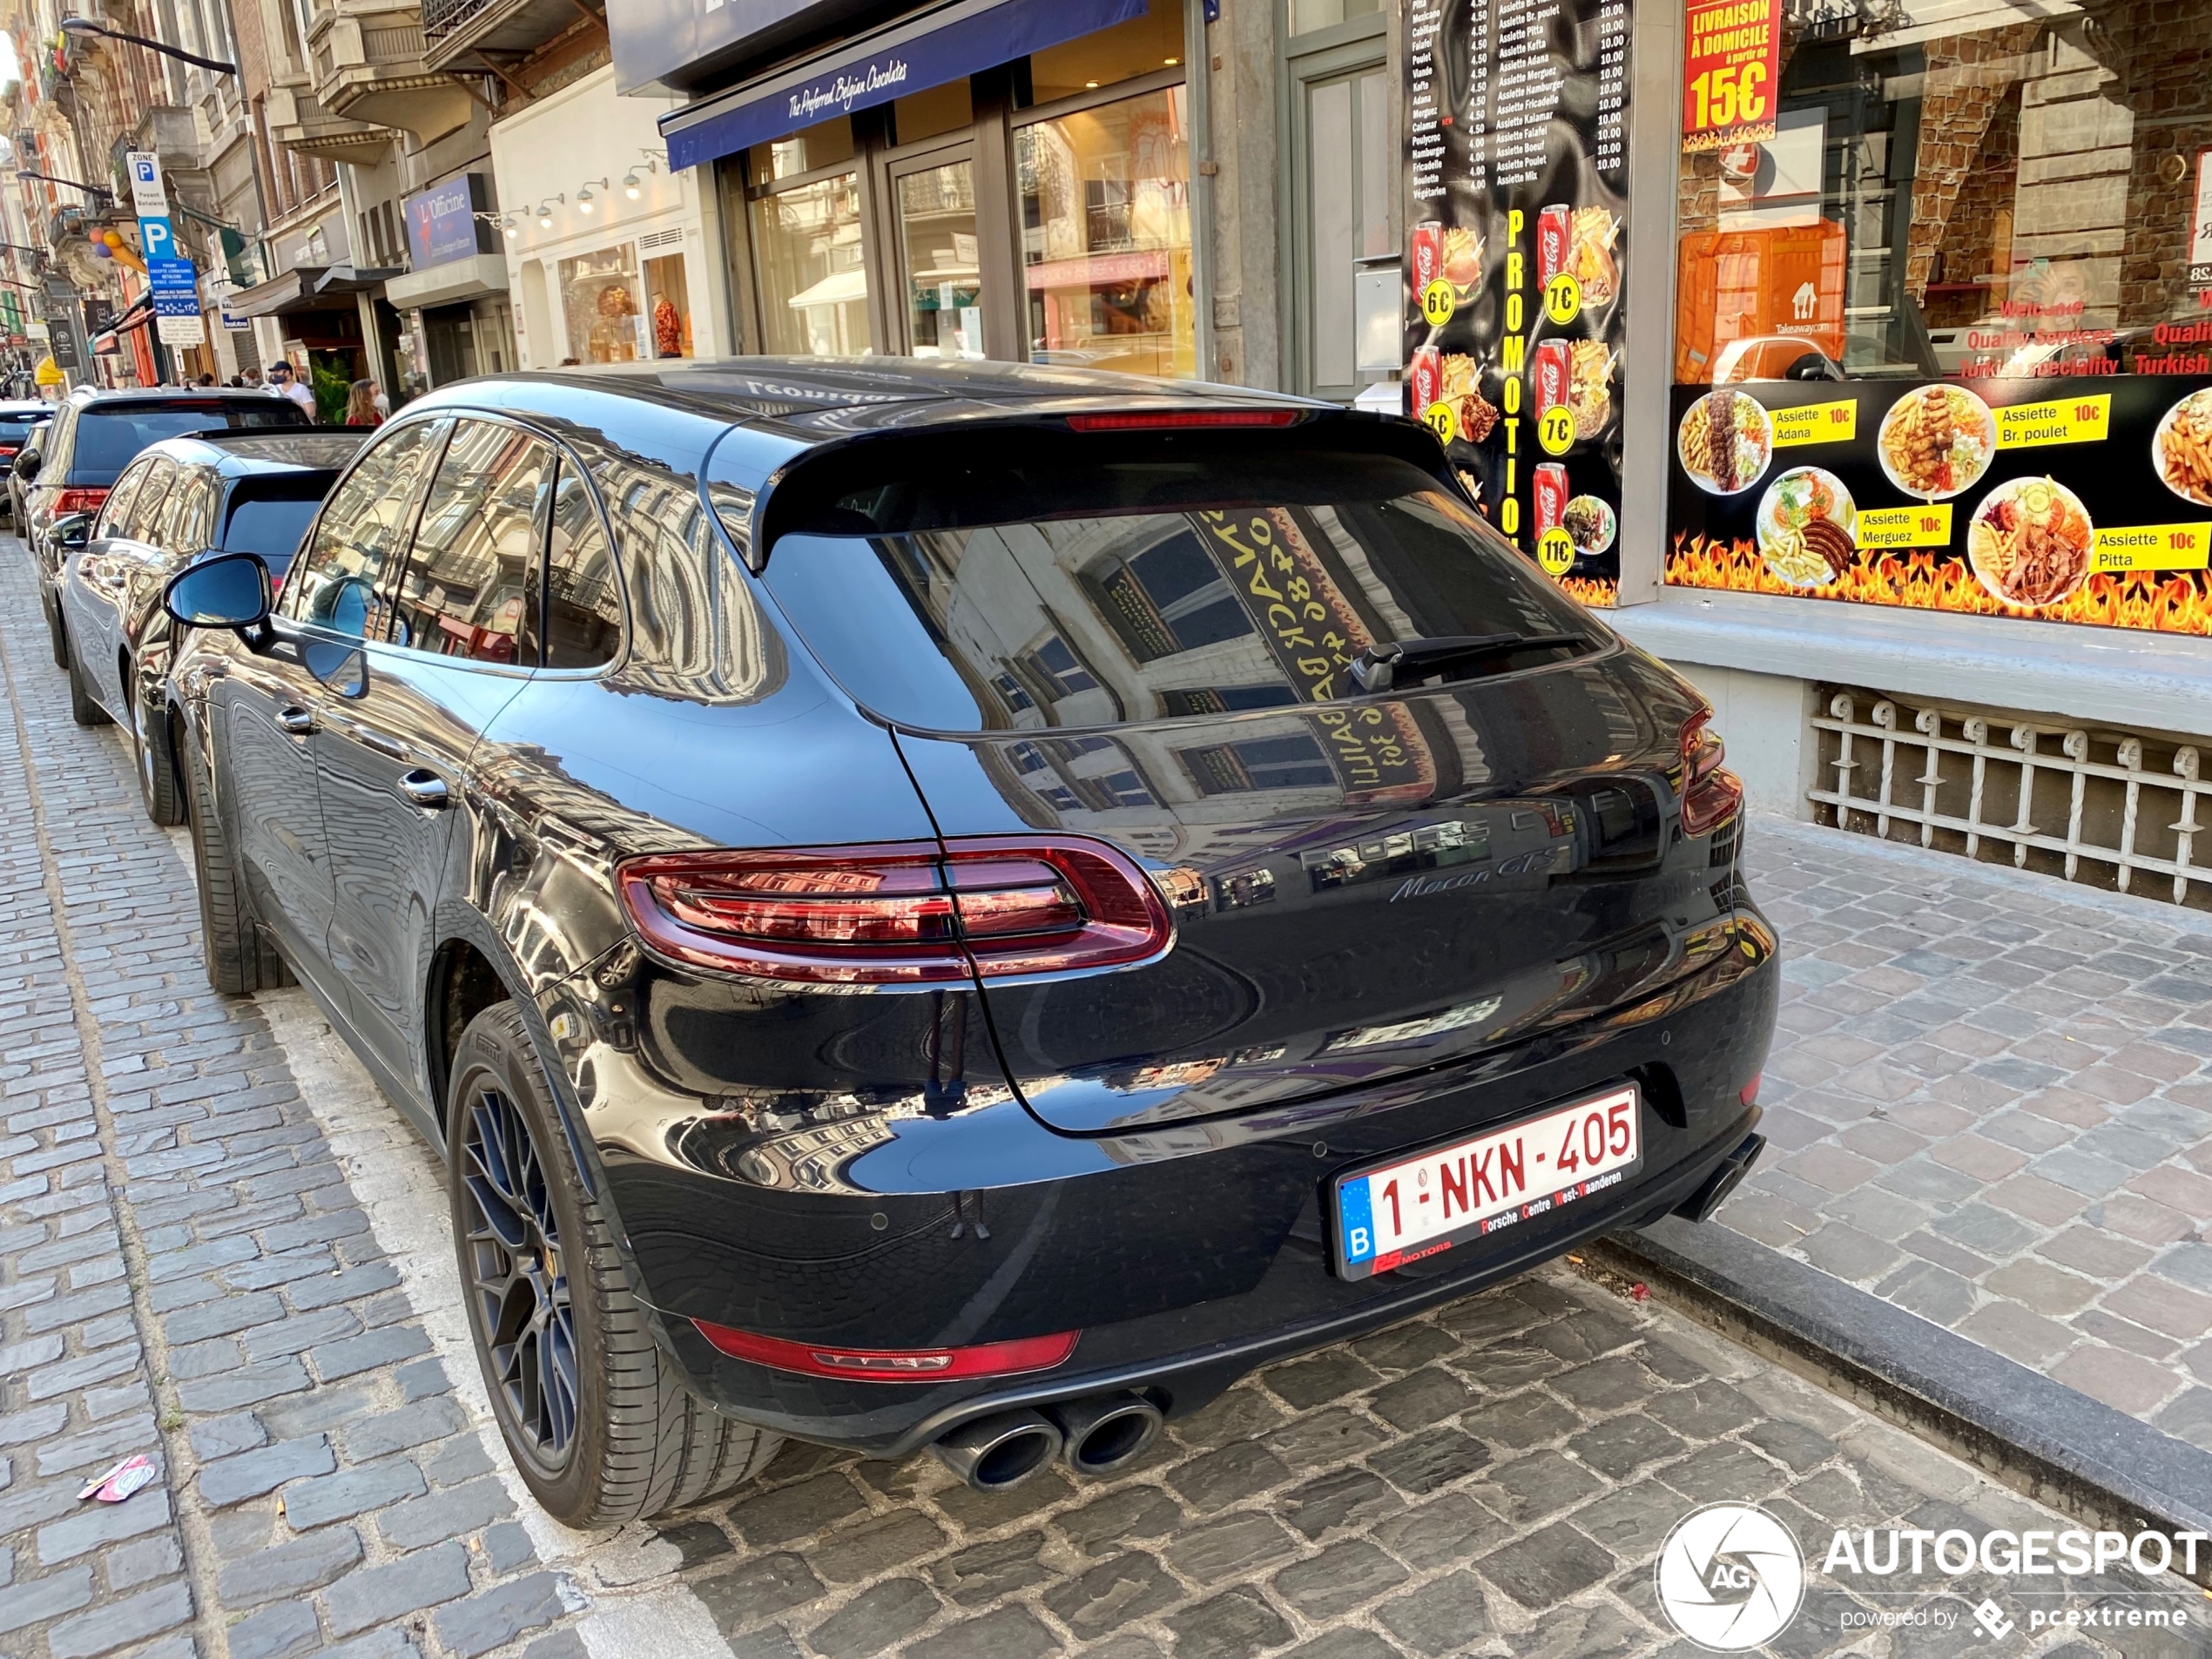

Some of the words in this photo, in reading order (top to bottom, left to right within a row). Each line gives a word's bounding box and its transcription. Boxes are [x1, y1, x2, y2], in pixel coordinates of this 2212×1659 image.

[1413, 10, 1440, 24] Mexicano
[1499, 0, 1525, 15] Assiette
[1499, 16, 1525, 29] Assiette
[1527, 11, 1536, 22] Br.
[1538, 4, 1560, 21] poulet
[1692, 0, 1770, 35] LIVRAISON
[1413, 22, 1440, 37] Cabillaud
[1471, 10, 1487, 23] 4.50
[1499, 30, 1526, 44] Assiette
[1527, 25, 1543, 37] Pitta
[1601, 3, 1623, 18] 10.00
[1413, 37, 1433, 52] Falafel
[1471, 24, 1487, 37] 4.50
[1500, 44, 1526, 58] Assiette
[1527, 39, 1546, 51] Kefta
[1601, 19, 1623, 34] 10.00
[1691, 33, 1701, 58] À
[1703, 24, 1770, 57] DOMICILE
[1413, 52, 1432, 65] Poulet
[1471, 39, 1487, 51] 4.50
[1500, 59, 1526, 72] Assiette
[1527, 54, 1549, 66] Adana
[1601, 35, 1624, 50] 10.00
[1726, 53, 1731, 64] à
[1732, 49, 1756, 64] partir
[1757, 47, 1768, 58] de
[1413, 66, 1433, 79] Viande
[1471, 53, 1487, 65] 4.50
[1471, 67, 1487, 79] 4.50
[1499, 73, 1526, 87] Assiette
[1527, 67, 1556, 80] Merguez
[1601, 51, 1623, 64] 10.00
[789, 95, 800, 118] The
[800, 83, 835, 118] Preferred
[835, 75, 866, 111] Belgian
[867, 59, 907, 91] Chocolates
[1413, 95, 1432, 106] Adana
[1470, 81, 1487, 93] 4.50
[1498, 87, 1525, 101] Assiette
[1526, 80, 1564, 95] Hamburger
[1600, 65, 1622, 80] 10.00
[1690, 61, 1767, 129] 15€
[1413, 107, 1438, 119] Merguez
[1470, 96, 1486, 107] 4.50
[1497, 101, 1523, 115] Assiette
[1525, 95, 1559, 110] Fricadelle
[1599, 81, 1622, 95] 10.00
[1413, 120, 1438, 132] Calamar
[1441, 117, 1453, 126] NEW
[1469, 110, 1486, 121] 4.50
[1496, 116, 1522, 130] Assiette
[1525, 111, 1553, 124] Kalamar
[1599, 97, 1622, 111] 10.00
[1468, 124, 1485, 135] 4.50
[1496, 130, 1522, 144] Assiette
[1524, 125, 1548, 138] Falafel
[1598, 112, 1621, 125] 10.00
[1413, 146, 1446, 159] Hamburger
[1468, 138, 1485, 149] 4.00
[1496, 144, 1523, 158] Assiette
[1525, 140, 1545, 152] Boeuf
[1598, 127, 1621, 140] 10.00
[1413, 159, 1442, 172] Fricadelle
[1469, 152, 1485, 163] 4.00
[1496, 158, 1523, 172] Assiette
[1525, 154, 1547, 167] Poulet
[1597, 142, 1621, 155] 10.00
[138, 164, 151, 180] P
[1413, 173, 1440, 185] Boulette
[1469, 165, 1486, 177] 4.00
[1497, 172, 1524, 185] Assiette
[1525, 171, 1538, 181] Mix
[1597, 157, 1621, 170] 10.00
[1413, 186, 1447, 200] Végétarien
[1470, 179, 1486, 190] 4.00
[421, 192, 466, 224] L'Officine
[145, 224, 168, 255] P
[1428, 292, 1448, 314] 6€
[1550, 286, 1572, 310] 7€
[1776, 322, 1830, 335] Takeaway.com
[1967, 330, 2030, 352] Quality
[2033, 326, 2115, 347] Services
[2134, 353, 2209, 375] Turkish
[1776, 409, 1819, 424] Assiette
[1830, 408, 1850, 424] 10€
[2002, 407, 2057, 423] Assiette
[2074, 404, 2100, 422] 10€
[1547, 418, 1568, 442] 7€
[1777, 428, 1811, 441] Adana
[2003, 429, 2020, 442] Br.
[2025, 425, 2068, 443] poulet
[1864, 513, 1910, 526] Assiette
[1919, 516, 1941, 533] 10€
[1863, 531, 1912, 545] Merguez
[2099, 533, 2158, 547] Assiette
[2168, 532, 2195, 550] 10€
[1545, 539, 1569, 563] 11€
[2099, 553, 2133, 567] Pitta
[1390, 870, 1490, 903] Macan
[1497, 846, 1559, 879] GTS
[1481, 1211, 1518, 1235] Porsche
[1522, 1198, 1551, 1219] Centre
[1554, 1171, 1622, 1207] West-Vlaanderen
[1350, 1227, 1370, 1257] B
[1372, 1250, 1402, 1276] RS
[1402, 1240, 1453, 1264] MOTORS
